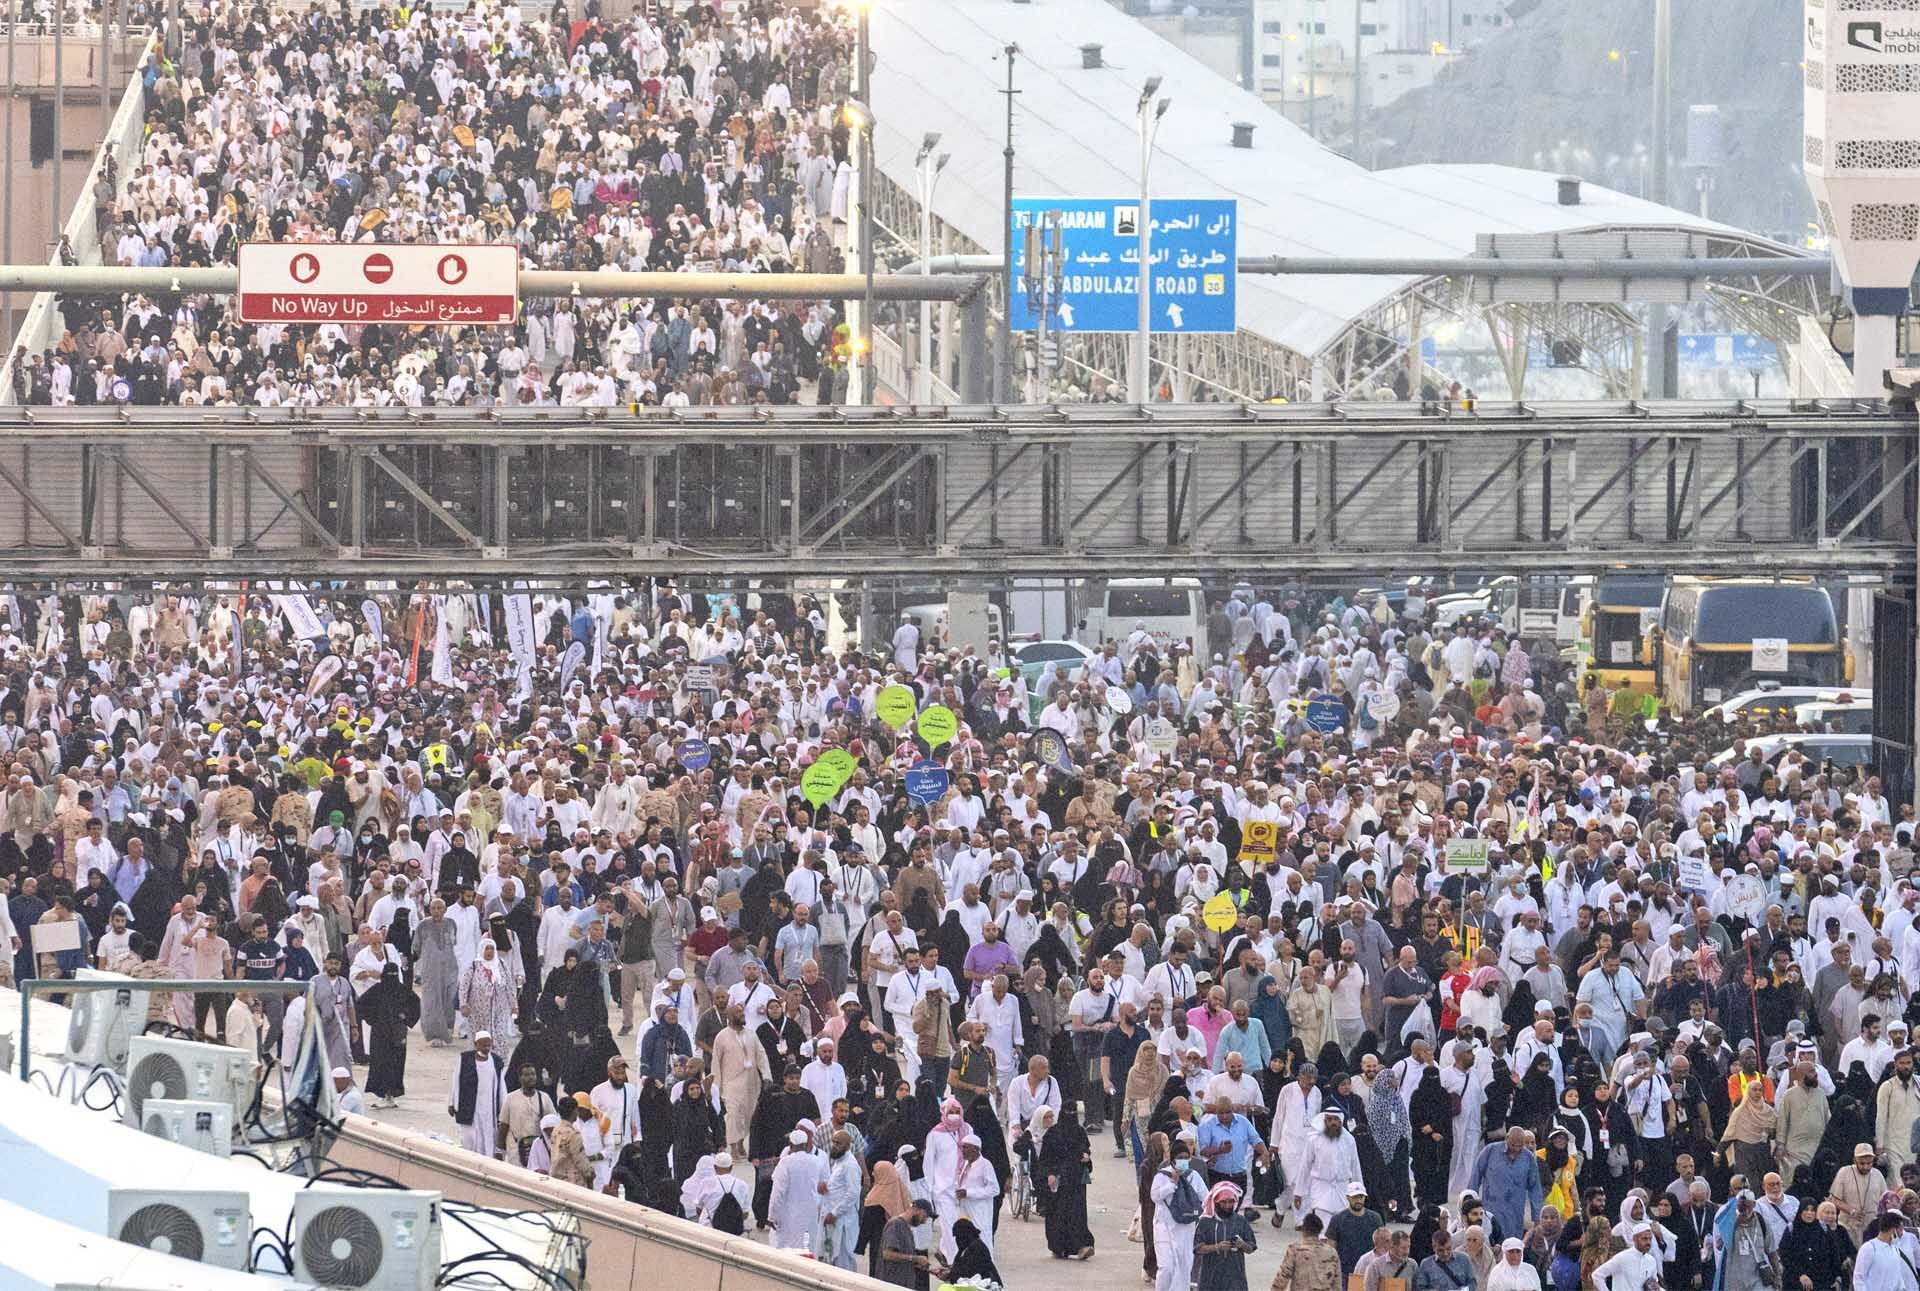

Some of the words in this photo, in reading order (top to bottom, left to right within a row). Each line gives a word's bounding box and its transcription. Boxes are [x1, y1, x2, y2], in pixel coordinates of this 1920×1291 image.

[1149, 213, 1199, 239] الحرم
[1206, 213, 1230, 235] إلى
[1076, 250, 1111, 268] عبد
[1177, 248, 1226, 268] طريق
[1156, 276, 1197, 294] ROAD
[272, 297, 297, 314] No
[301, 297, 338, 317] Way
[343, 298, 368, 317] Up
[382, 299, 434, 318] الدخول
[438, 302, 483, 320] ممنوع
